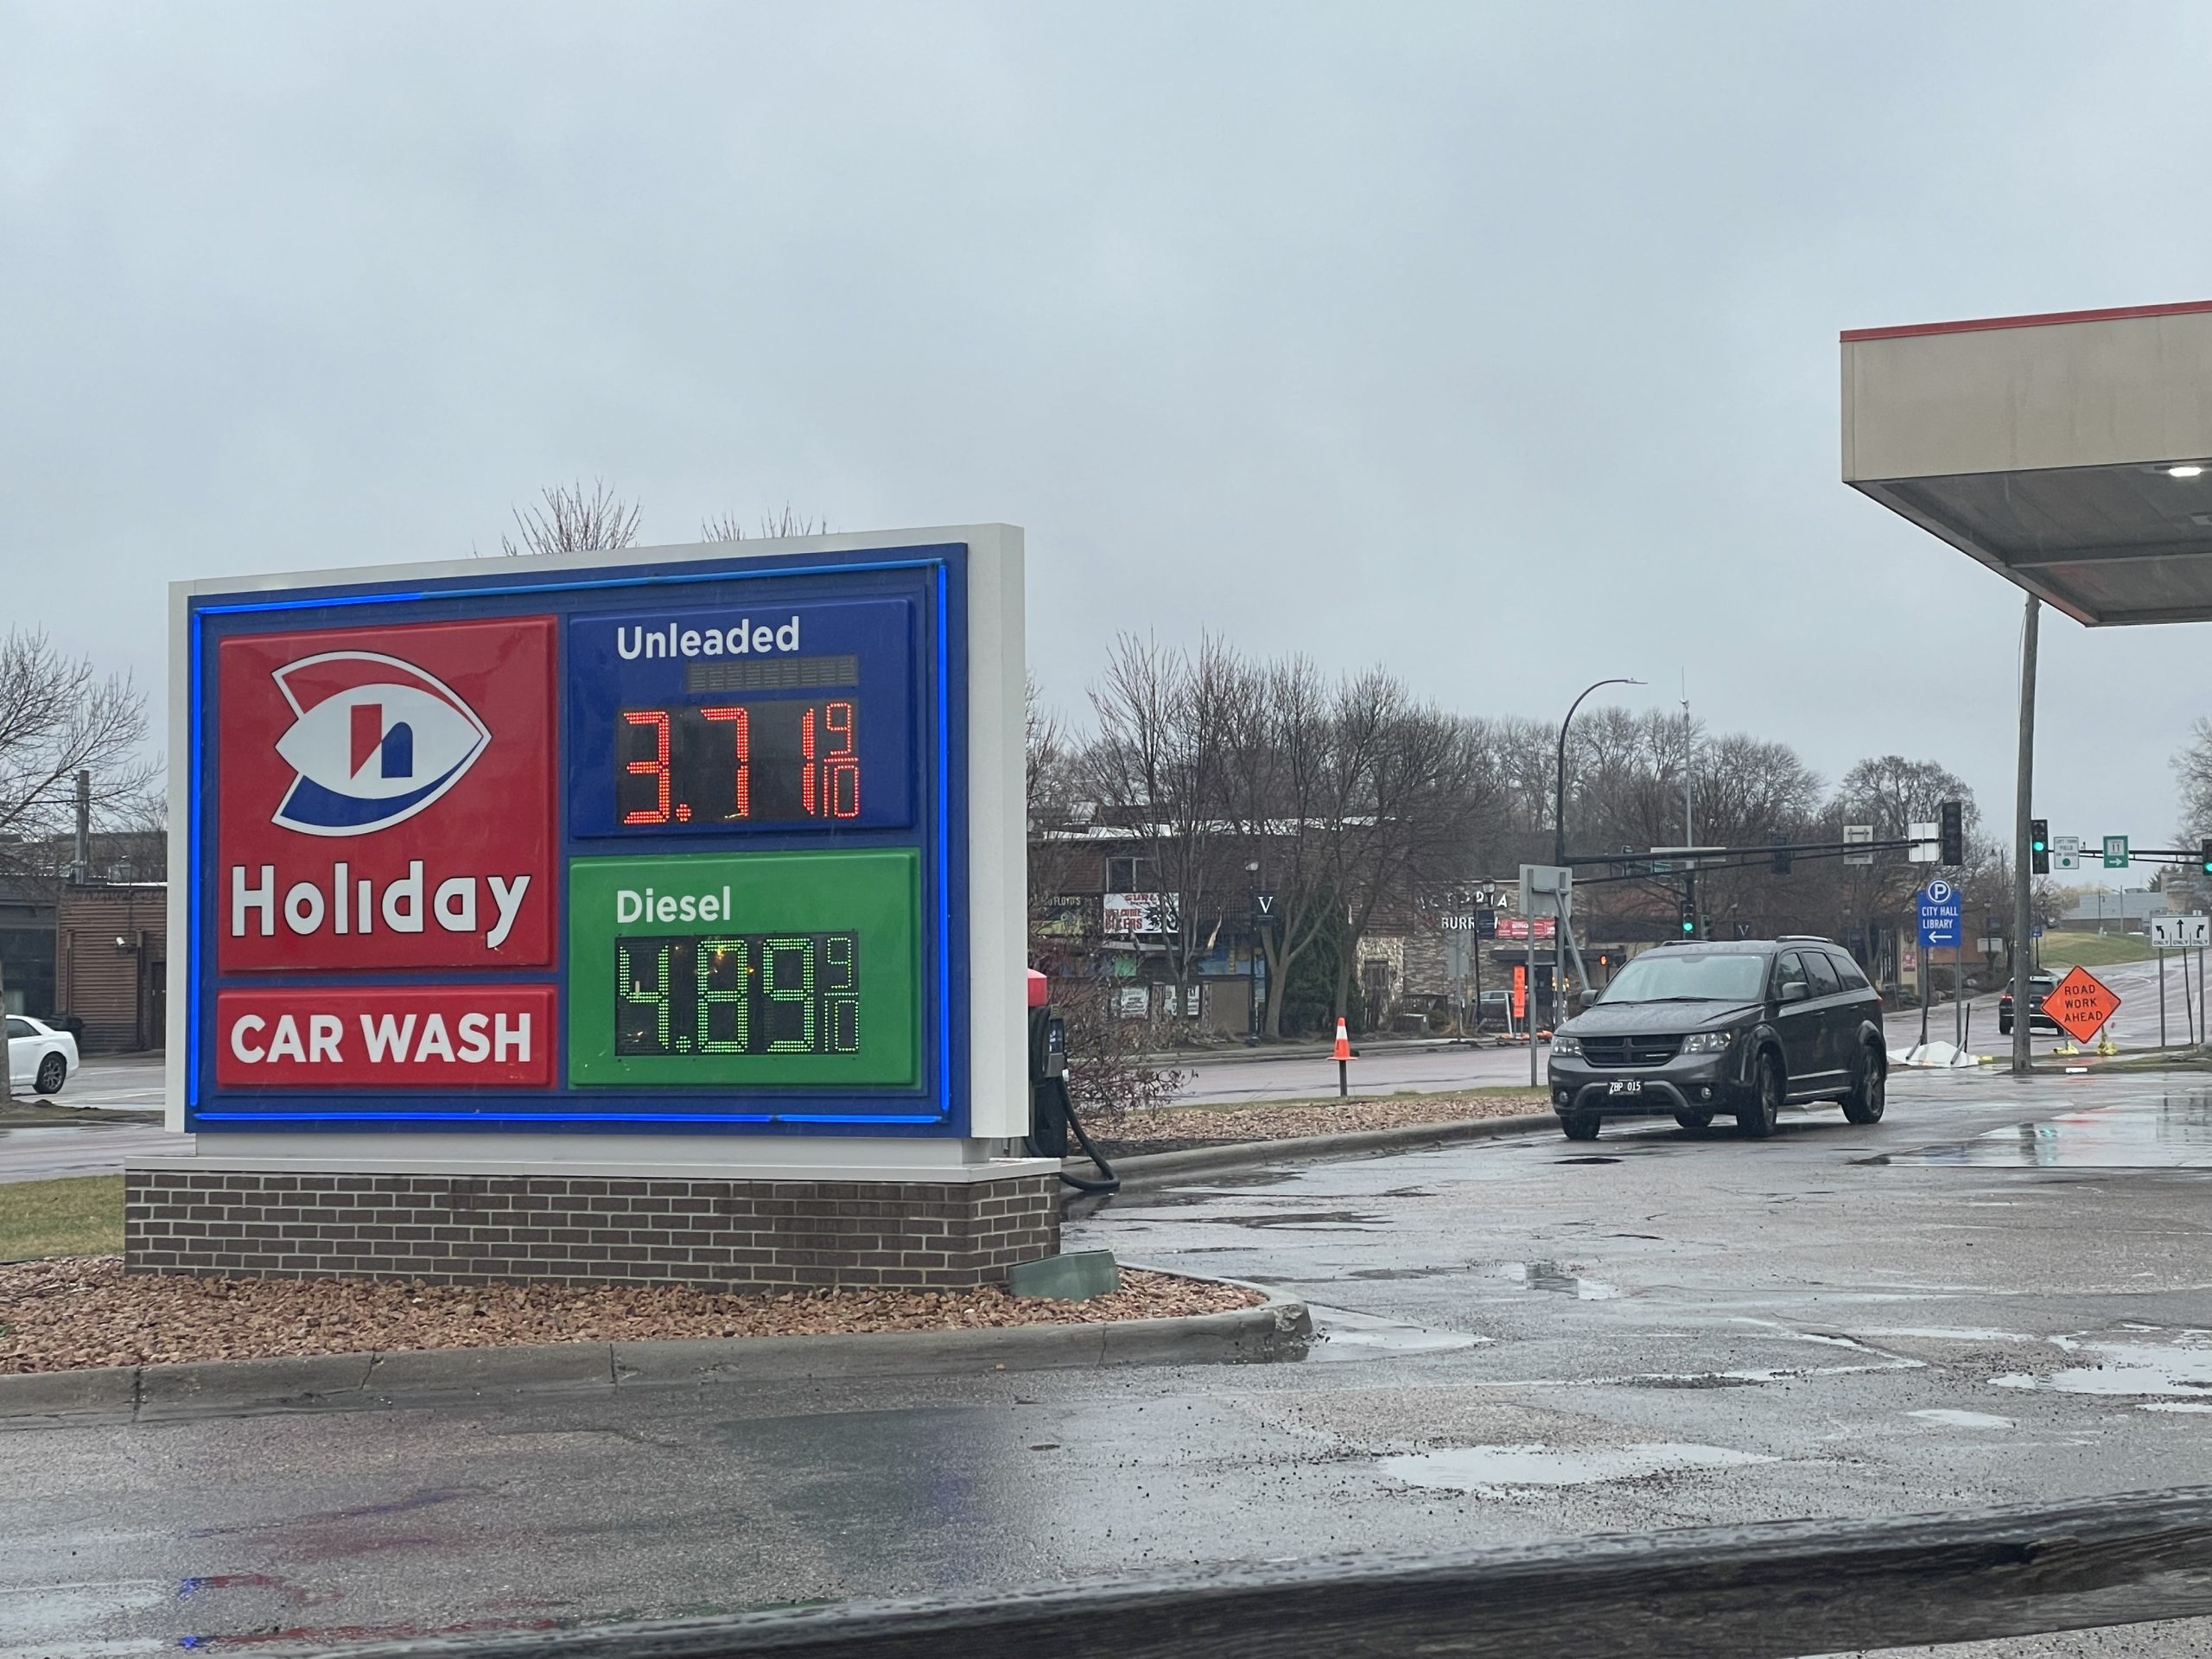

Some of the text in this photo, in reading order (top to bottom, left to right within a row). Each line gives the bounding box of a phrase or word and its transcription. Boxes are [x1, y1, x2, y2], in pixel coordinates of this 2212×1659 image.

[617, 616, 800, 660] Unleaded
[232, 860, 531, 950] Holiday
[617, 887, 731, 924] Diesel
[1257, 896, 1274, 913] V
[1922, 906, 1959, 916] CITY HALL
[1923, 919, 1953, 929] LIBRARY
[2064, 985, 2095, 995] ROAD
[2065, 997, 2097, 1008] WORK
[2064, 1011, 2103, 1022] AHEAD
[231, 1013, 531, 1064] CAR WASH
[1627, 1081, 1641, 1091] 015
